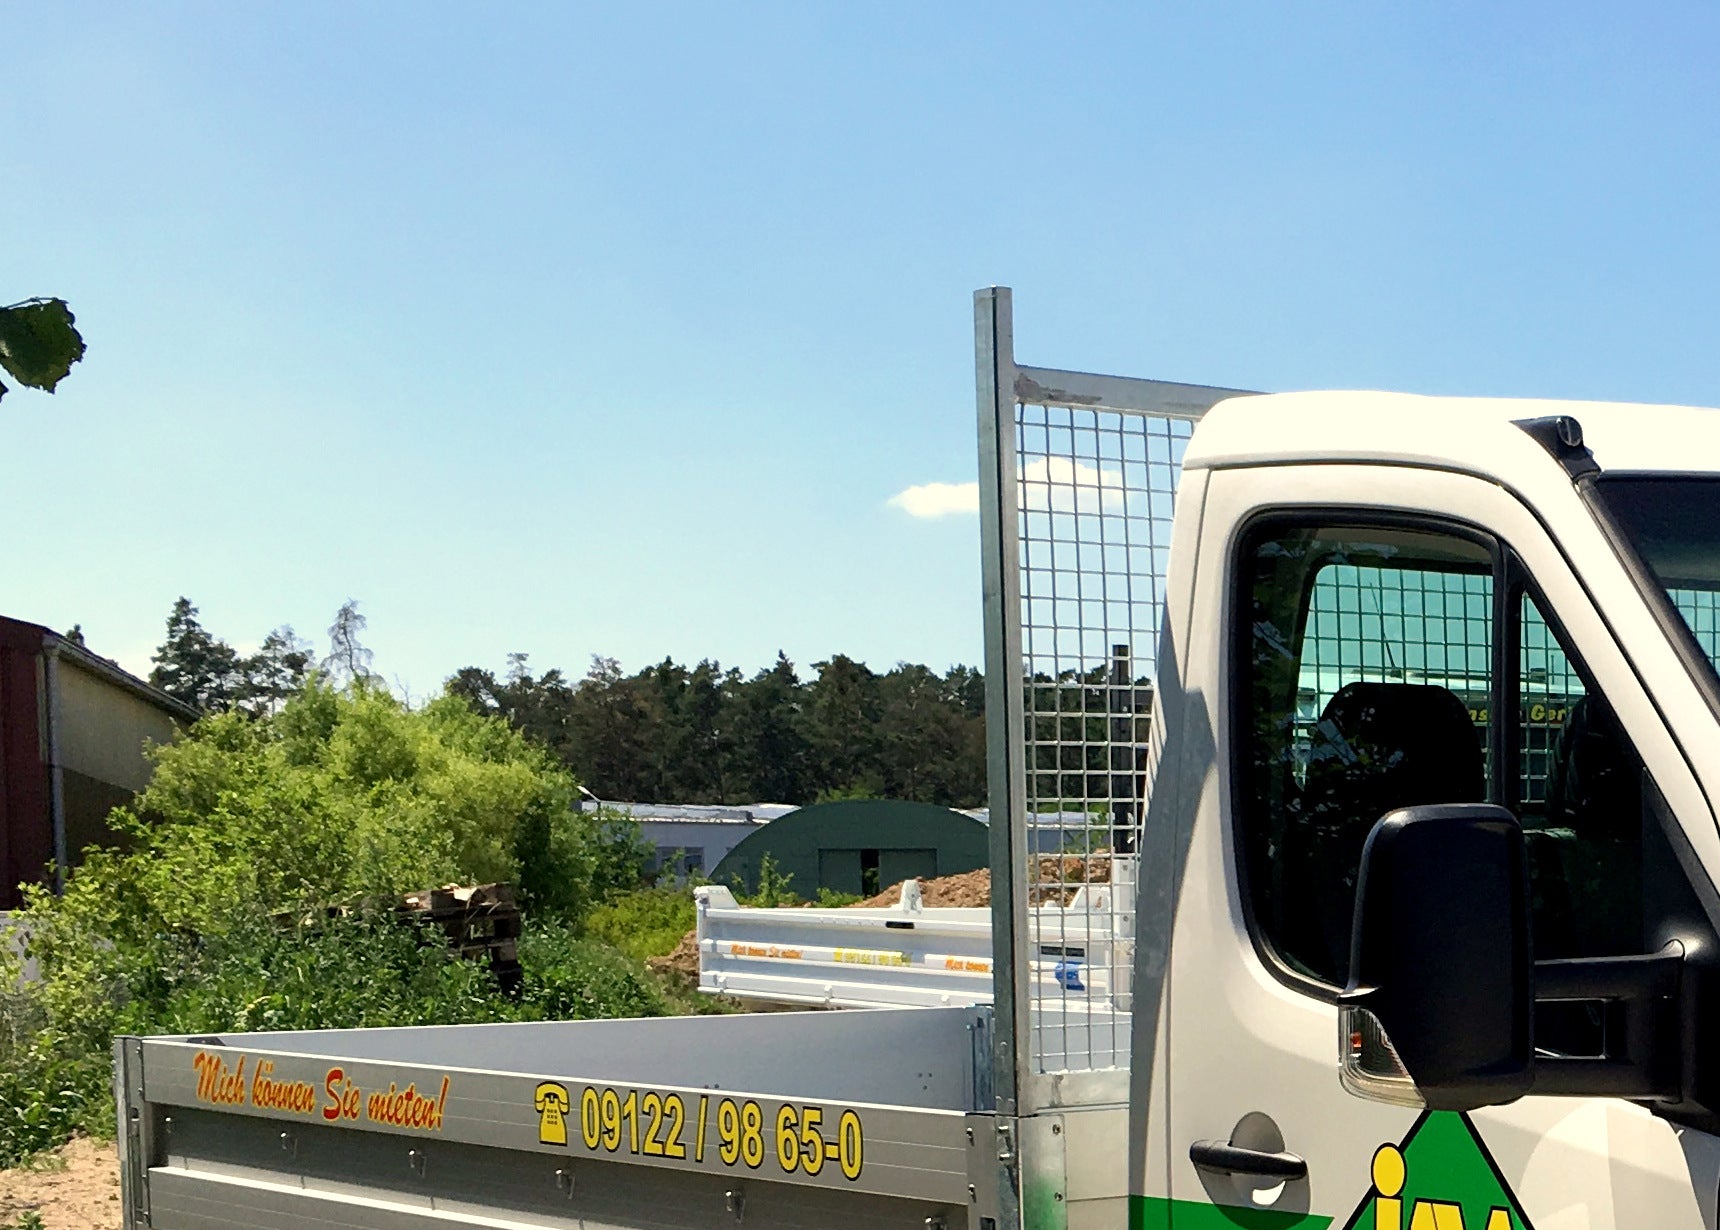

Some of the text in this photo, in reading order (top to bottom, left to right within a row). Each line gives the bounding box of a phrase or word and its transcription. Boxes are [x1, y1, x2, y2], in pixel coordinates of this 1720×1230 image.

[193, 1051, 450, 1131] Mich können Sie mieten!
[581, 1086, 686, 1160] 09122
[717, 1098, 764, 1169] 98
[776, 1103, 864, 1181] 65-0
